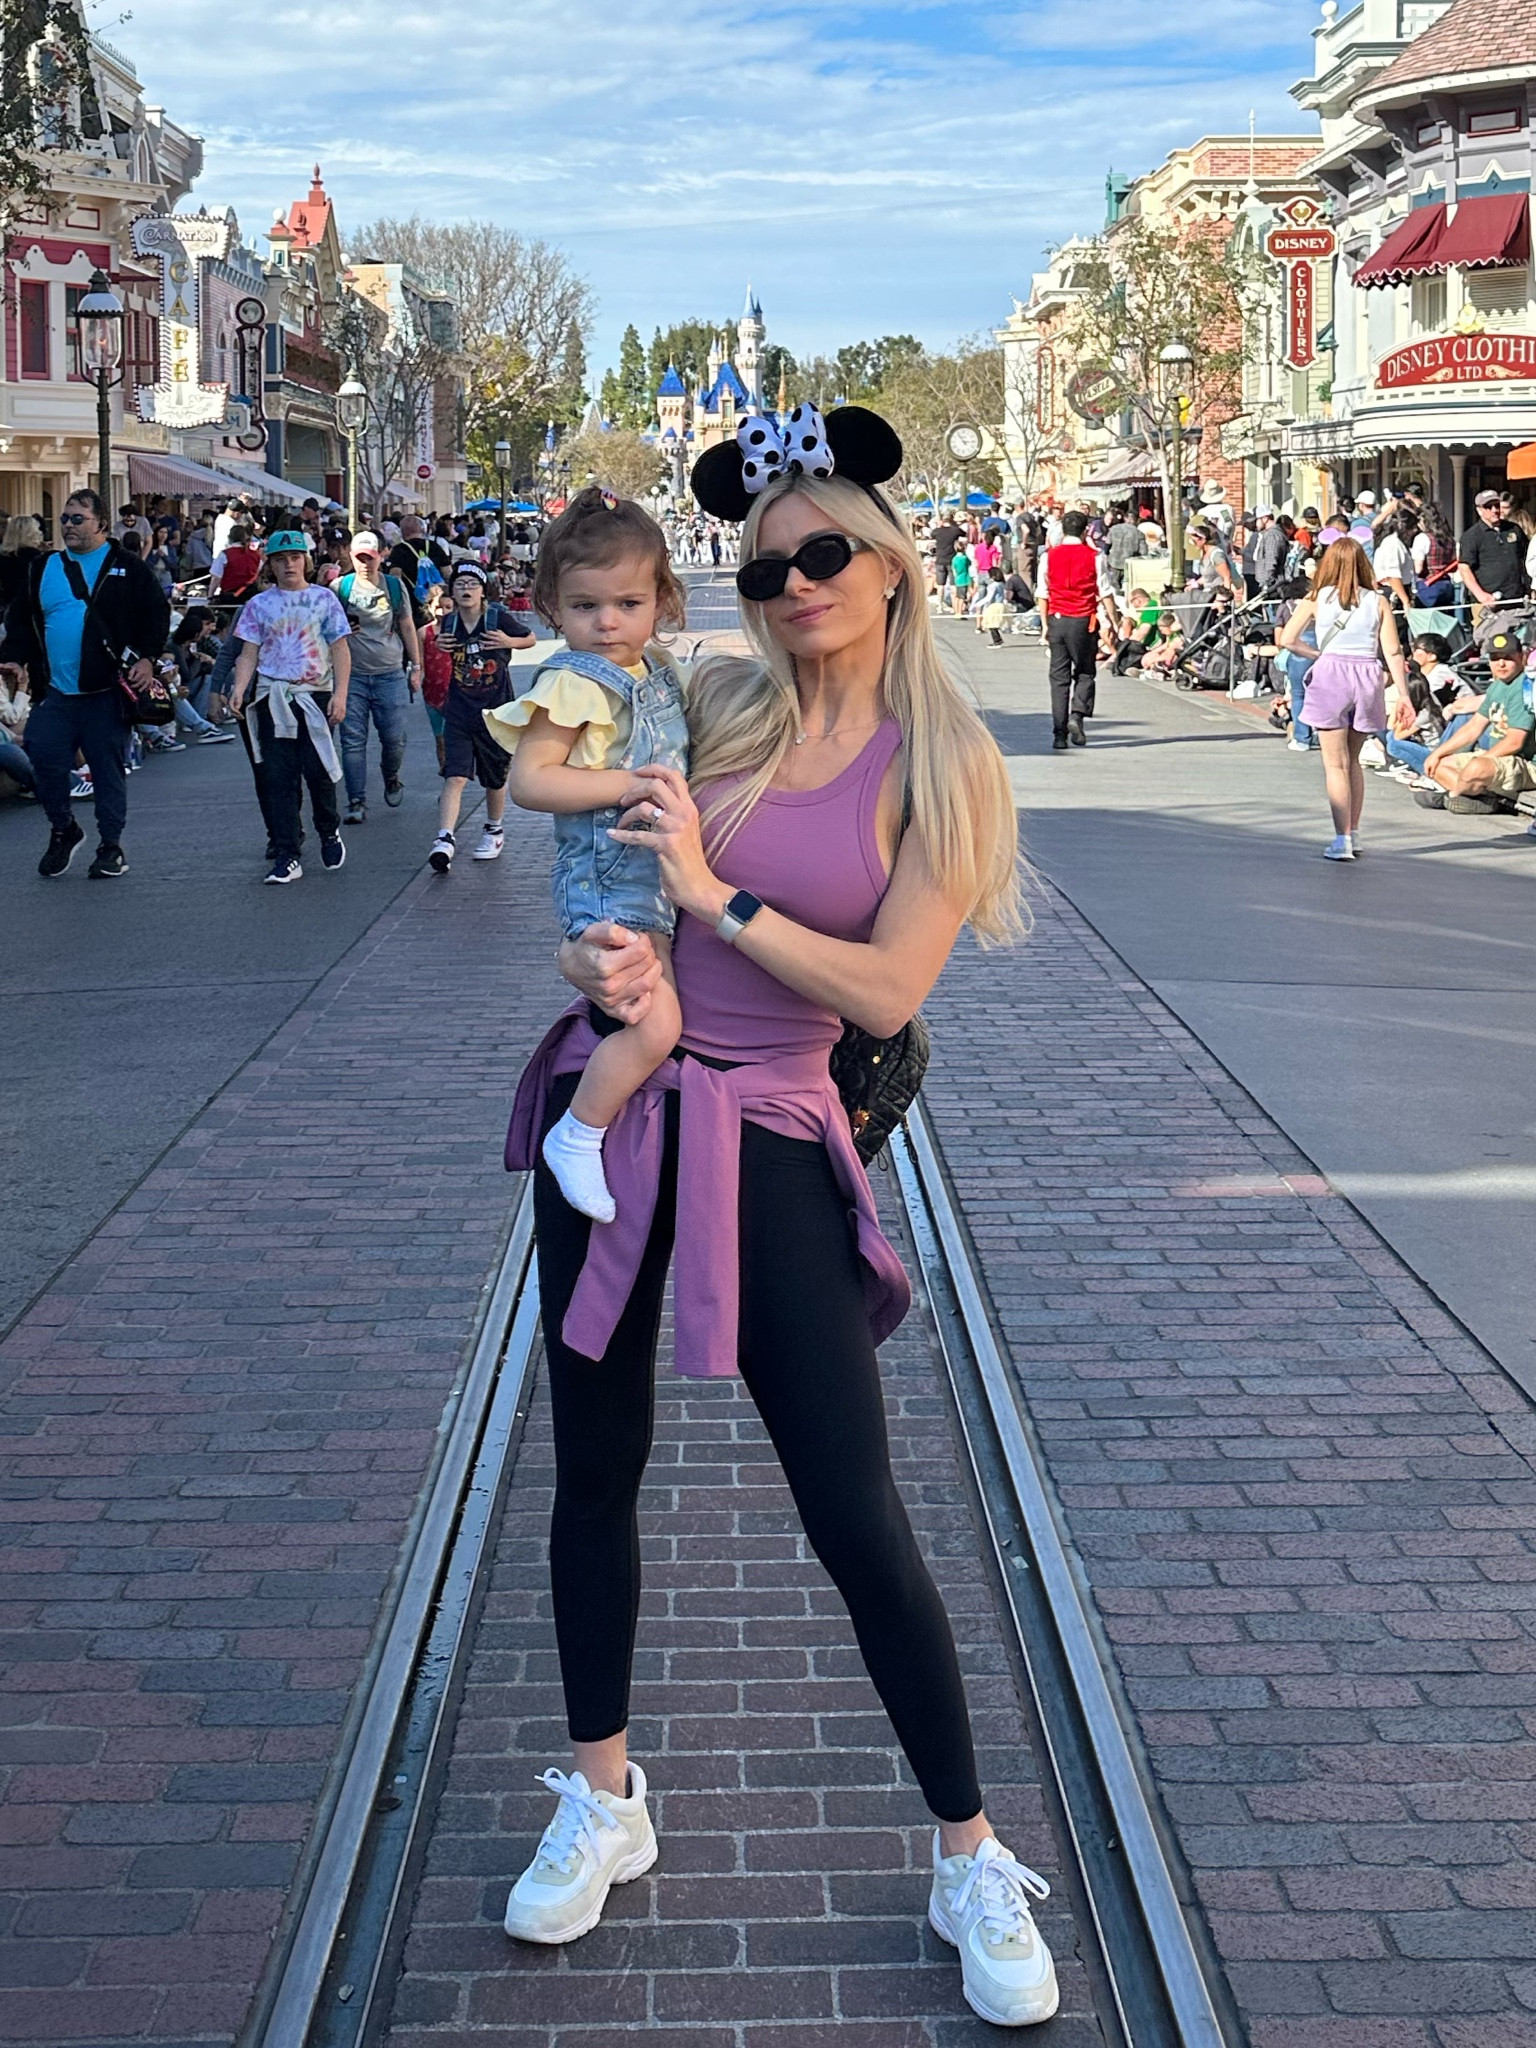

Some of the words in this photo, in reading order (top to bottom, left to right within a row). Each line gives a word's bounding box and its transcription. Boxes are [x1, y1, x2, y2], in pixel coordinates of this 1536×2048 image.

[141, 226, 218, 246] CARNATION
[1274, 238, 1328, 250] DISNEY
[1295, 267, 1308, 358] CLOTHIERS
[1387, 340, 1449, 383] DISNEY
